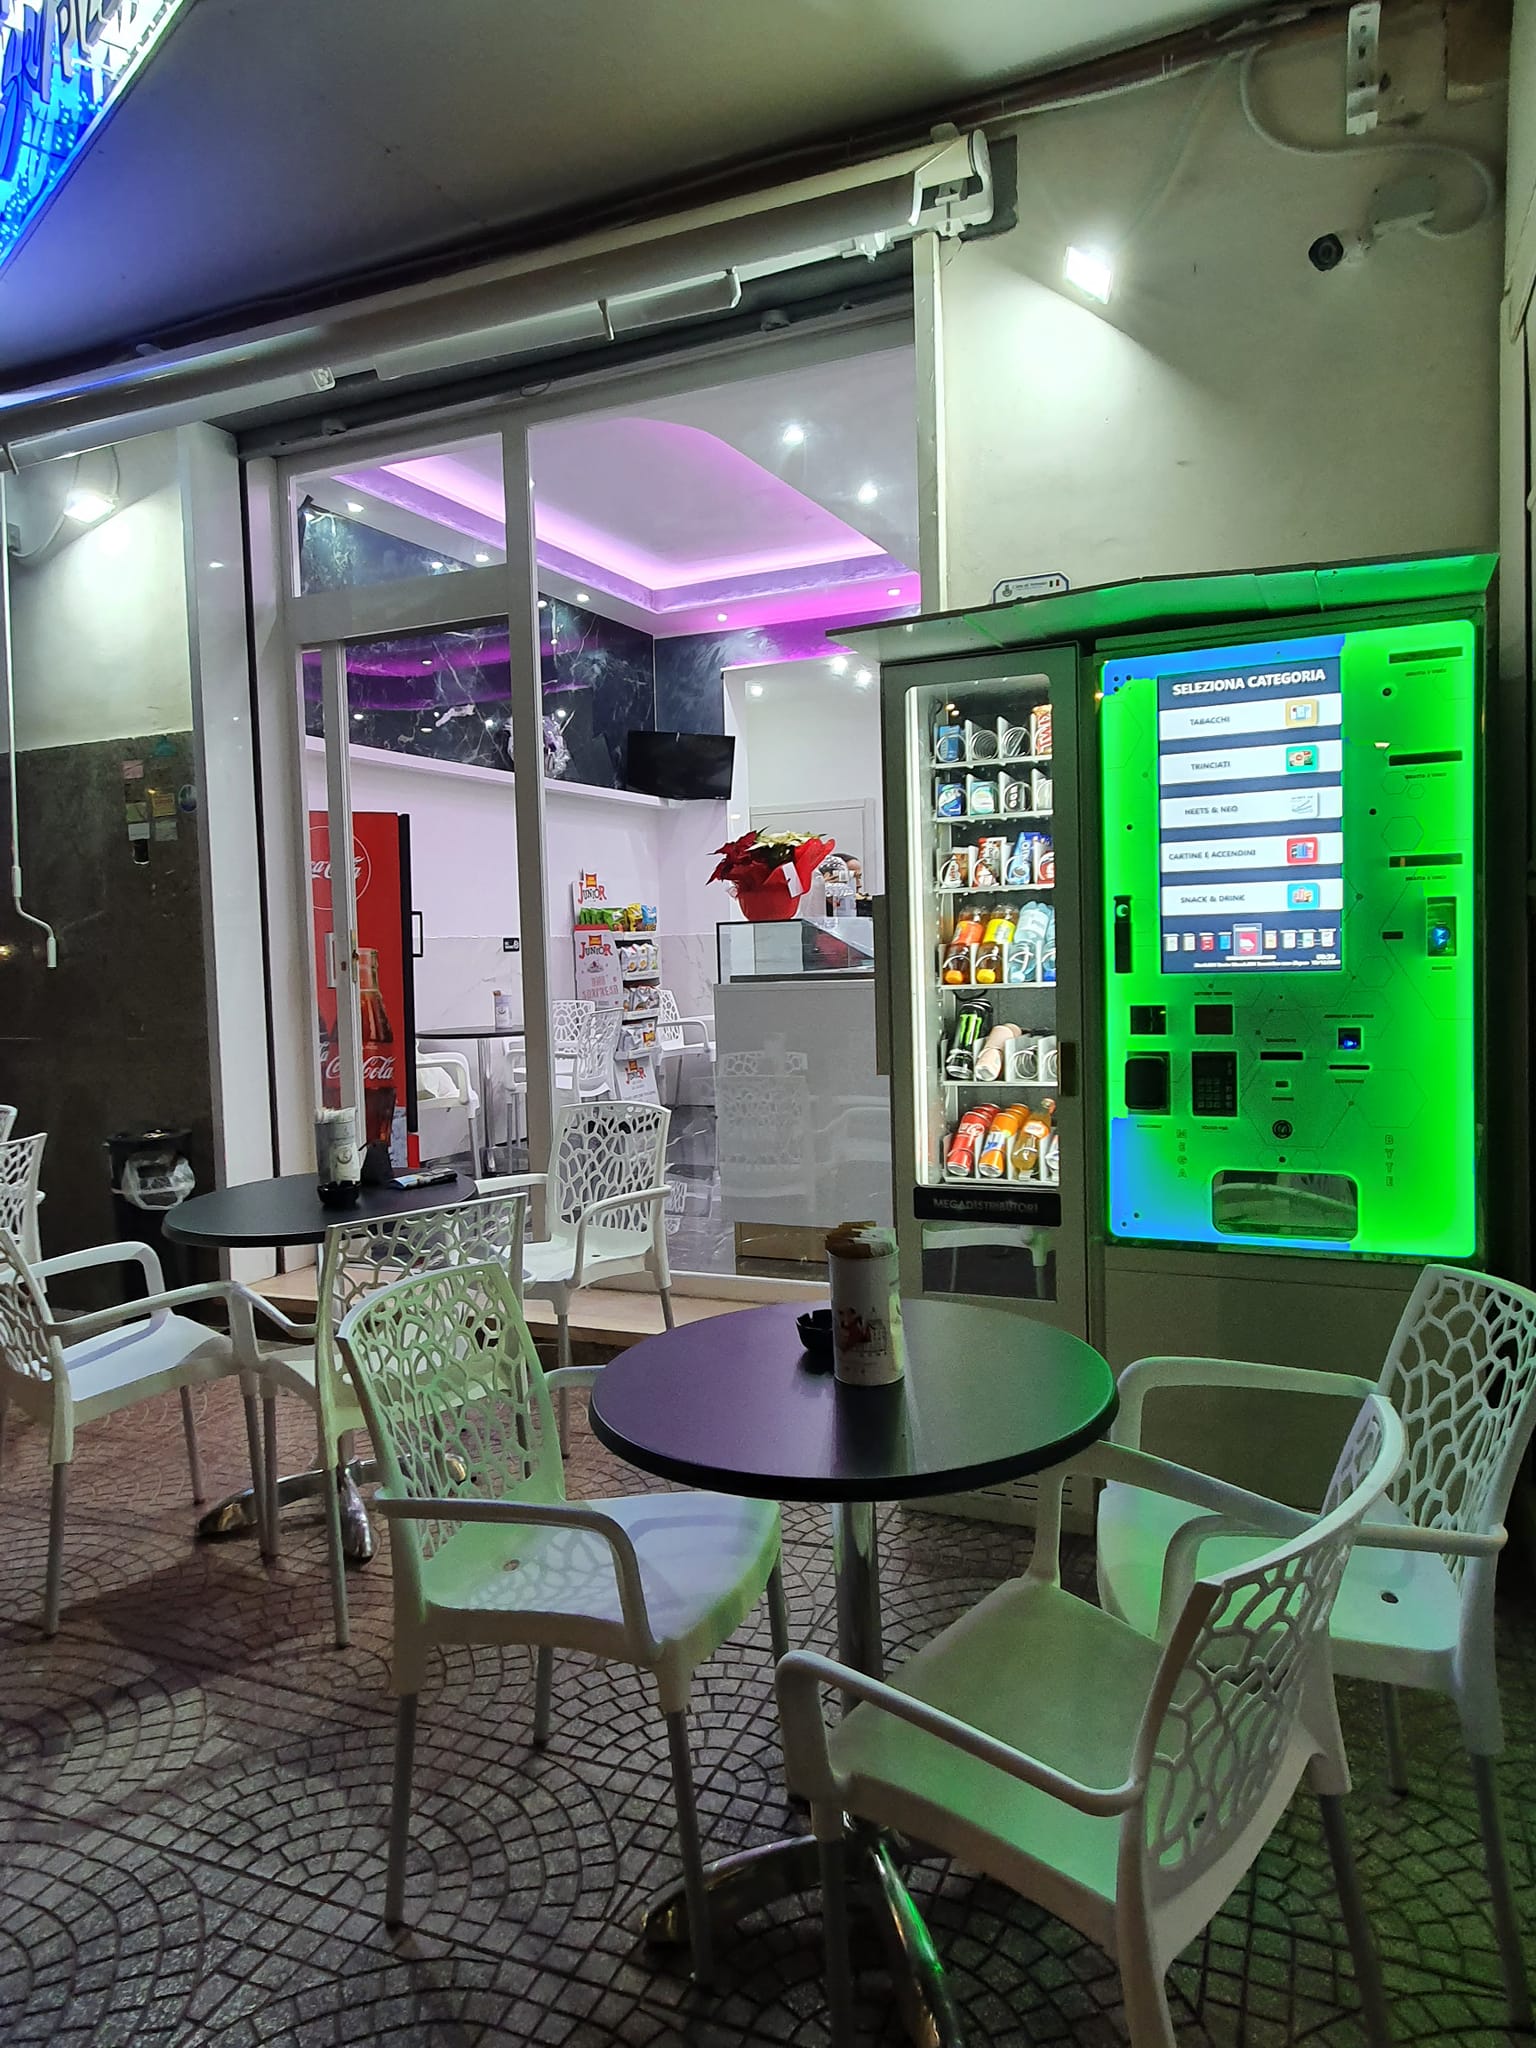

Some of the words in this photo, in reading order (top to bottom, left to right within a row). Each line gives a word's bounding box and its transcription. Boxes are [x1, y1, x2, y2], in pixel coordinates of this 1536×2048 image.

[1172, 678, 1245, 696] SELEZIONA
[1247, 668, 1326, 688] CATEGORIA
[1190, 716, 1230, 726] TABACCHI
[1190, 761, 1231, 771] TRINCIATI
[1221, 805, 1239, 814] NEO
[1168, 851, 1202, 861] CARTINE
[1211, 849, 1256, 859] ACCENDINI
[578, 882, 607, 904] JUNIOR
[1180, 895, 1208, 904] SNACK
[1219, 894, 1246, 903] DRINK
[579, 942, 613, 960] JUNIOR
